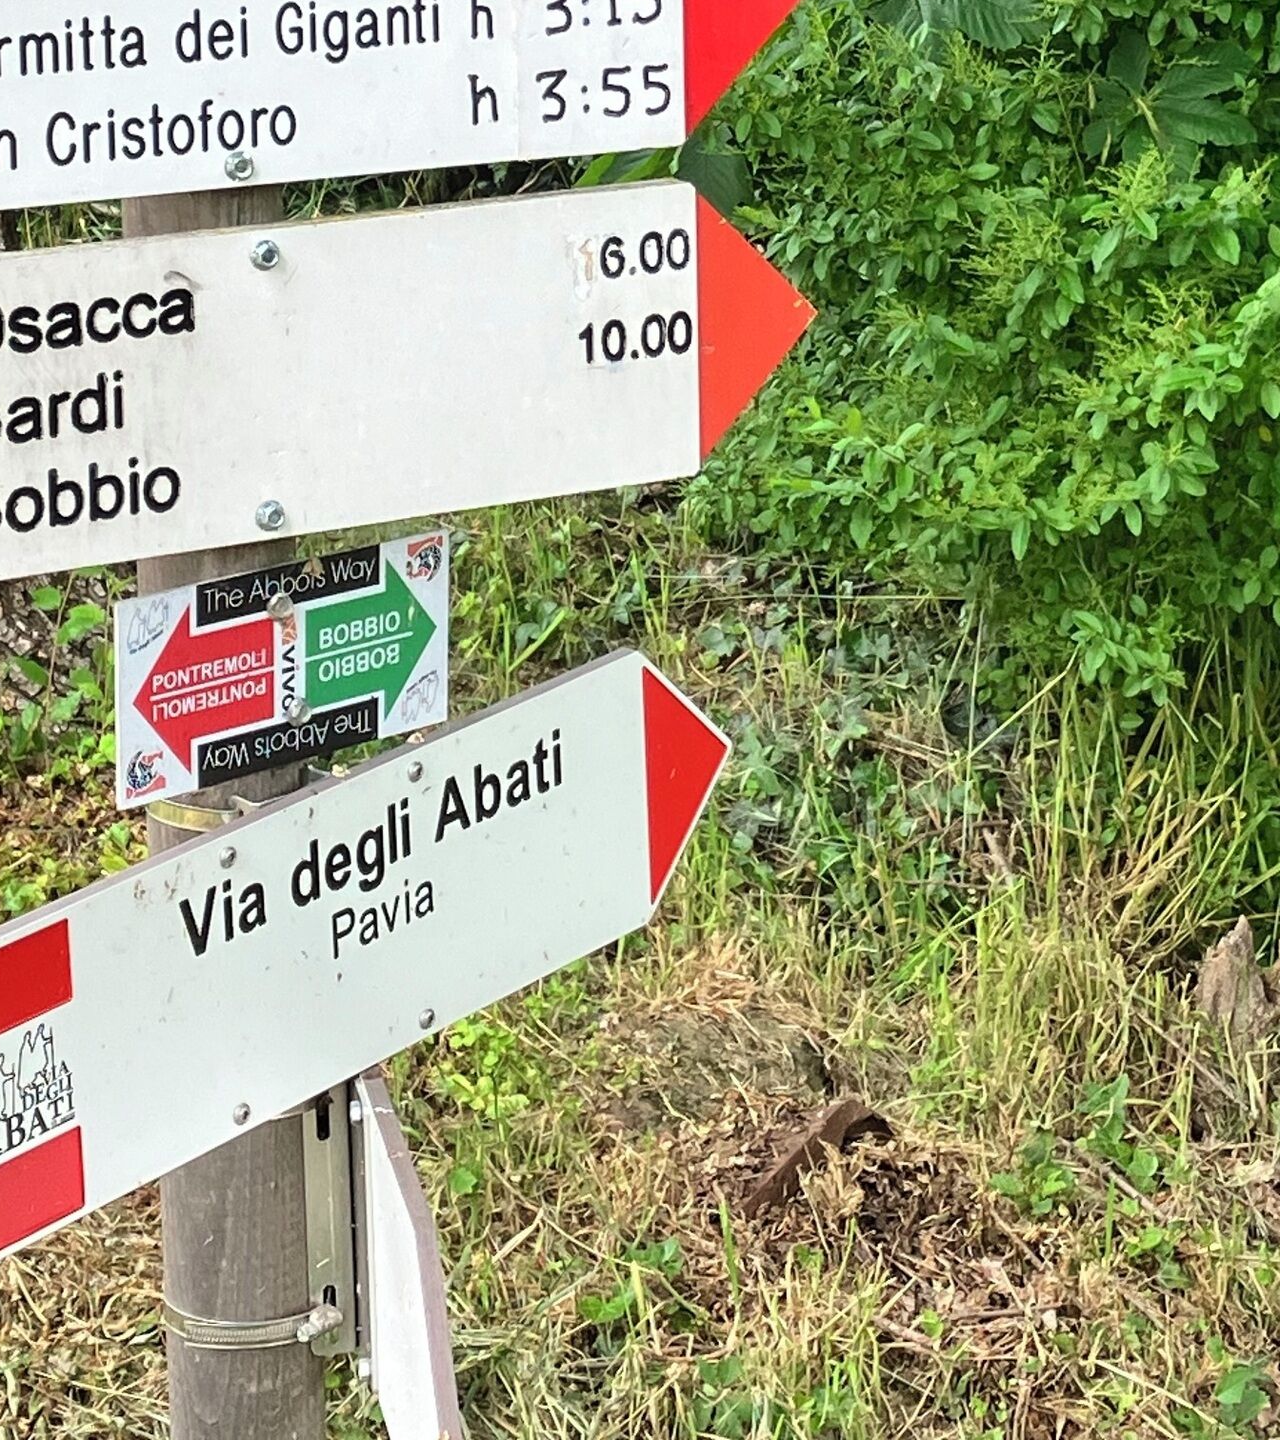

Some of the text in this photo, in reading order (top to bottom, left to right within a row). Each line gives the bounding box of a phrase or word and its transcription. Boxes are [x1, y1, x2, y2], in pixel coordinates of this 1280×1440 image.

[175, 6, 249, 63] dei
[46, 100, 297, 168] Cristoforo
[468, 74, 499, 126] h
[535, 63, 671, 123] 3:55
[600, 228, 690, 279] 6.00
[578, 310, 693, 364] 10.00
[203, 588, 245, 614] The
[330, 557, 377, 584] Way
[319, 610, 401, 650] BOBBIO
[152, 647, 267, 694] PONTREMOLI
[318, 643, 400, 682] BOBBIO
[152, 676, 267, 723] PONTREMOLI
[201, 709, 372, 772] The Abbots Way
[179, 728, 562, 957] Via degli Abati
[331, 874, 435, 960] Pavia
[21, 1072, 74, 1112] DEGLI
